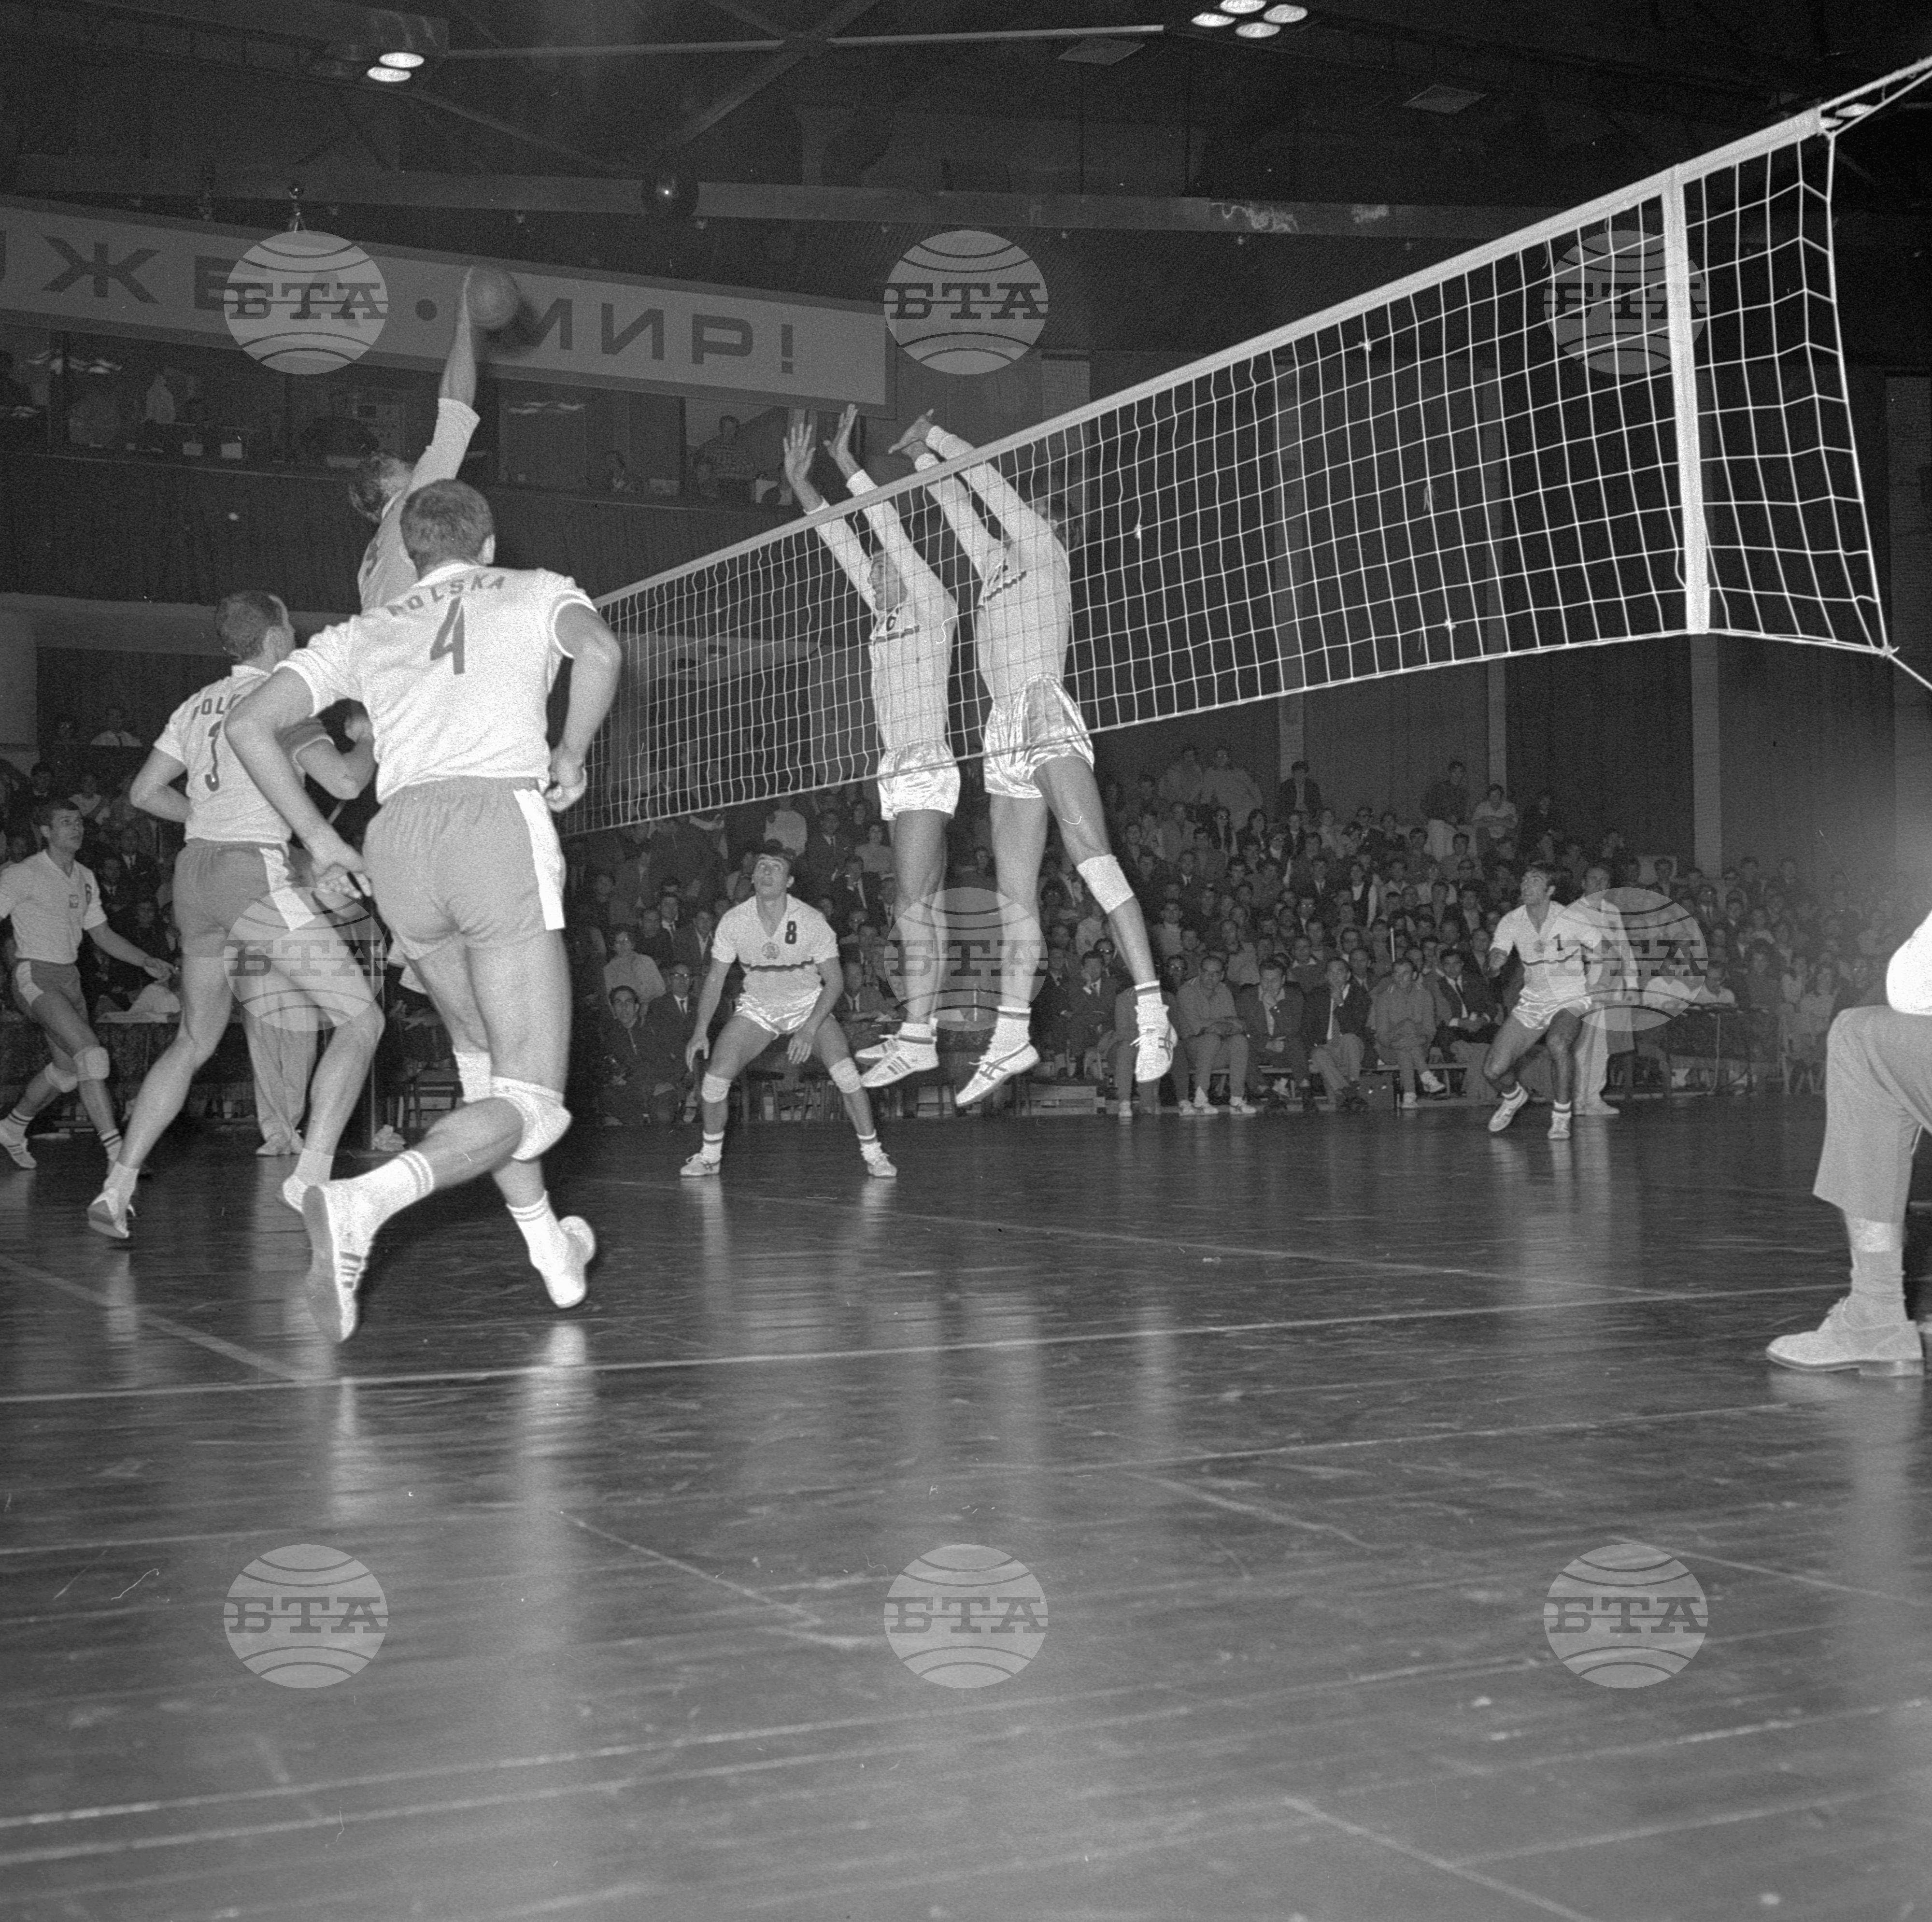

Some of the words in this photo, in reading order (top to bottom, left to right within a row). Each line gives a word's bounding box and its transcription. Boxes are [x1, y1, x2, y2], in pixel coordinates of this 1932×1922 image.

[429, 596, 465, 675] 4
[785, 920, 797, 944] 8
[1552, 933, 1564, 951] 1
